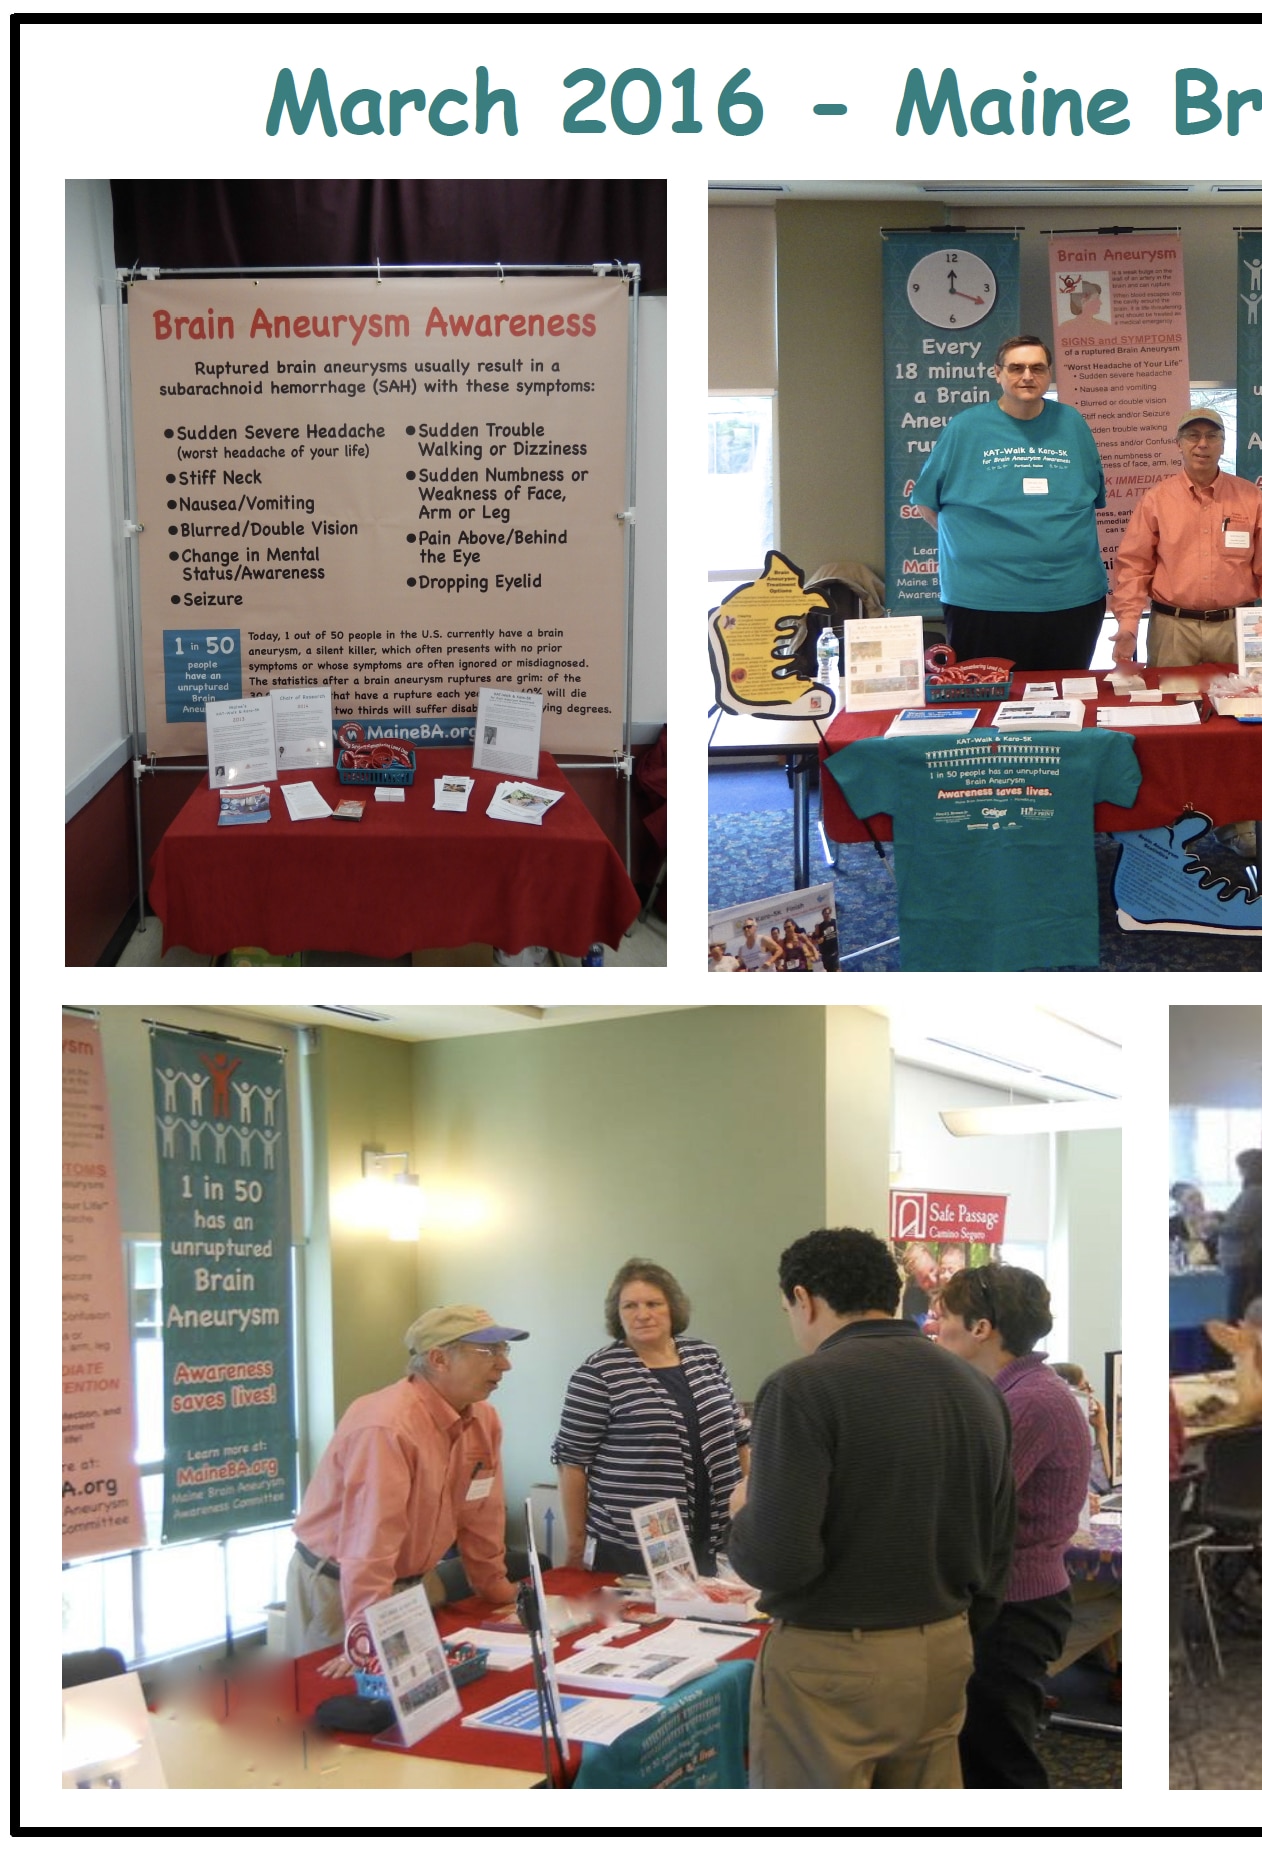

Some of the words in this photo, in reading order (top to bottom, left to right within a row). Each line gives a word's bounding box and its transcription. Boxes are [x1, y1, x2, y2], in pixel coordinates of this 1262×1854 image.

[1058, 250, 1097, 262] Brain
[1104, 249, 1177, 262] Aneurysm
[153, 308, 234, 340] Brain
[250, 308, 409, 346] Aneurysm
[425, 307, 597, 337] Awareness
[922, 338, 982, 358] Every
[1061, 337, 1095, 346] SIGNS
[1099, 337, 1118, 345] and
[1121, 333, 1182, 344] SYMPTOMS
[896, 363, 918, 379] 18
[929, 362, 999, 379] minute
[159, 381, 263, 396] subarachnoid
[271, 381, 366, 397] hemorrhage
[373, 378, 417, 395] (SAH)
[424, 379, 458, 392] with
[466, 379, 509, 392] these
[516, 379, 595, 396] symptoms:
[915, 391, 926, 403] a
[937, 386, 990, 403] Brain
[177, 425, 237, 440] Sudden
[245, 425, 300, 439] Severe
[307, 423, 385, 439] Headache
[177, 446, 218, 461] (worst
[224, 446, 286, 458] headache
[291, 445, 305, 458] of
[310, 447, 339, 460] your
[345, 444, 370, 458] life)
[983, 447, 1025, 457] KAT-Walk
[1038, 448, 1068, 456] Karo-5K
[179, 470, 216, 485] Stiff
[223, 469, 262, 485] Neck
[179, 494, 315, 514] Nausea/Vomiting
[181, 521, 305, 537] Blurred/Double
[312, 520, 358, 535] Vision
[183, 592, 243, 606] Seizure
[175, 637, 184, 655] 1
[190, 642, 199, 650] in
[206, 636, 234, 654] 50
[188, 661, 218, 670] people
[249, 662, 298, 672] symptoms
[318, 661, 348, 670] whose
[353, 661, 401, 671] symptoms
[407, 661, 423, 669] are
[428, 660, 454, 669] often
[459, 659, 497, 670] ignored
[517, 658, 589, 670] misdiagnosed.
[185, 672, 206, 680] have
[210, 672, 221, 680] an
[178, 683, 229, 693] unruptured
[960, 770, 985, 778] people
[1016, 768, 1059, 776] unruptured
[937, 788, 993, 799] Awareness
[996, 787, 1022, 796] saves
[1026, 786, 1052, 796] lives.
[182, 1175, 192, 1198] 1
[204, 1176, 224, 1200] in
[234, 1180, 262, 1202] 50
[194, 1210, 225, 1230] has
[233, 1215, 253, 1230] an
[929, 1202, 954, 1223] Safe
[958, 1204, 999, 1230] Passage
[929, 1226, 959, 1239] Camino
[961, 1227, 986, 1243] Seguro
[171, 1240, 272, 1262] unruptured
[194, 1268, 255, 1292] Brain
[166, 1304, 280, 1332] Aneurysm
[174, 1360, 273, 1386] Awareness
[172, 1391, 226, 1414] saves
[231, 1384, 277, 1406] lives!
[188, 1448, 220, 1461] Learn
[224, 1446, 249, 1457] more
[253, 1442, 267, 1451] at:
[176, 1458, 278, 1487] MaineBA.org
